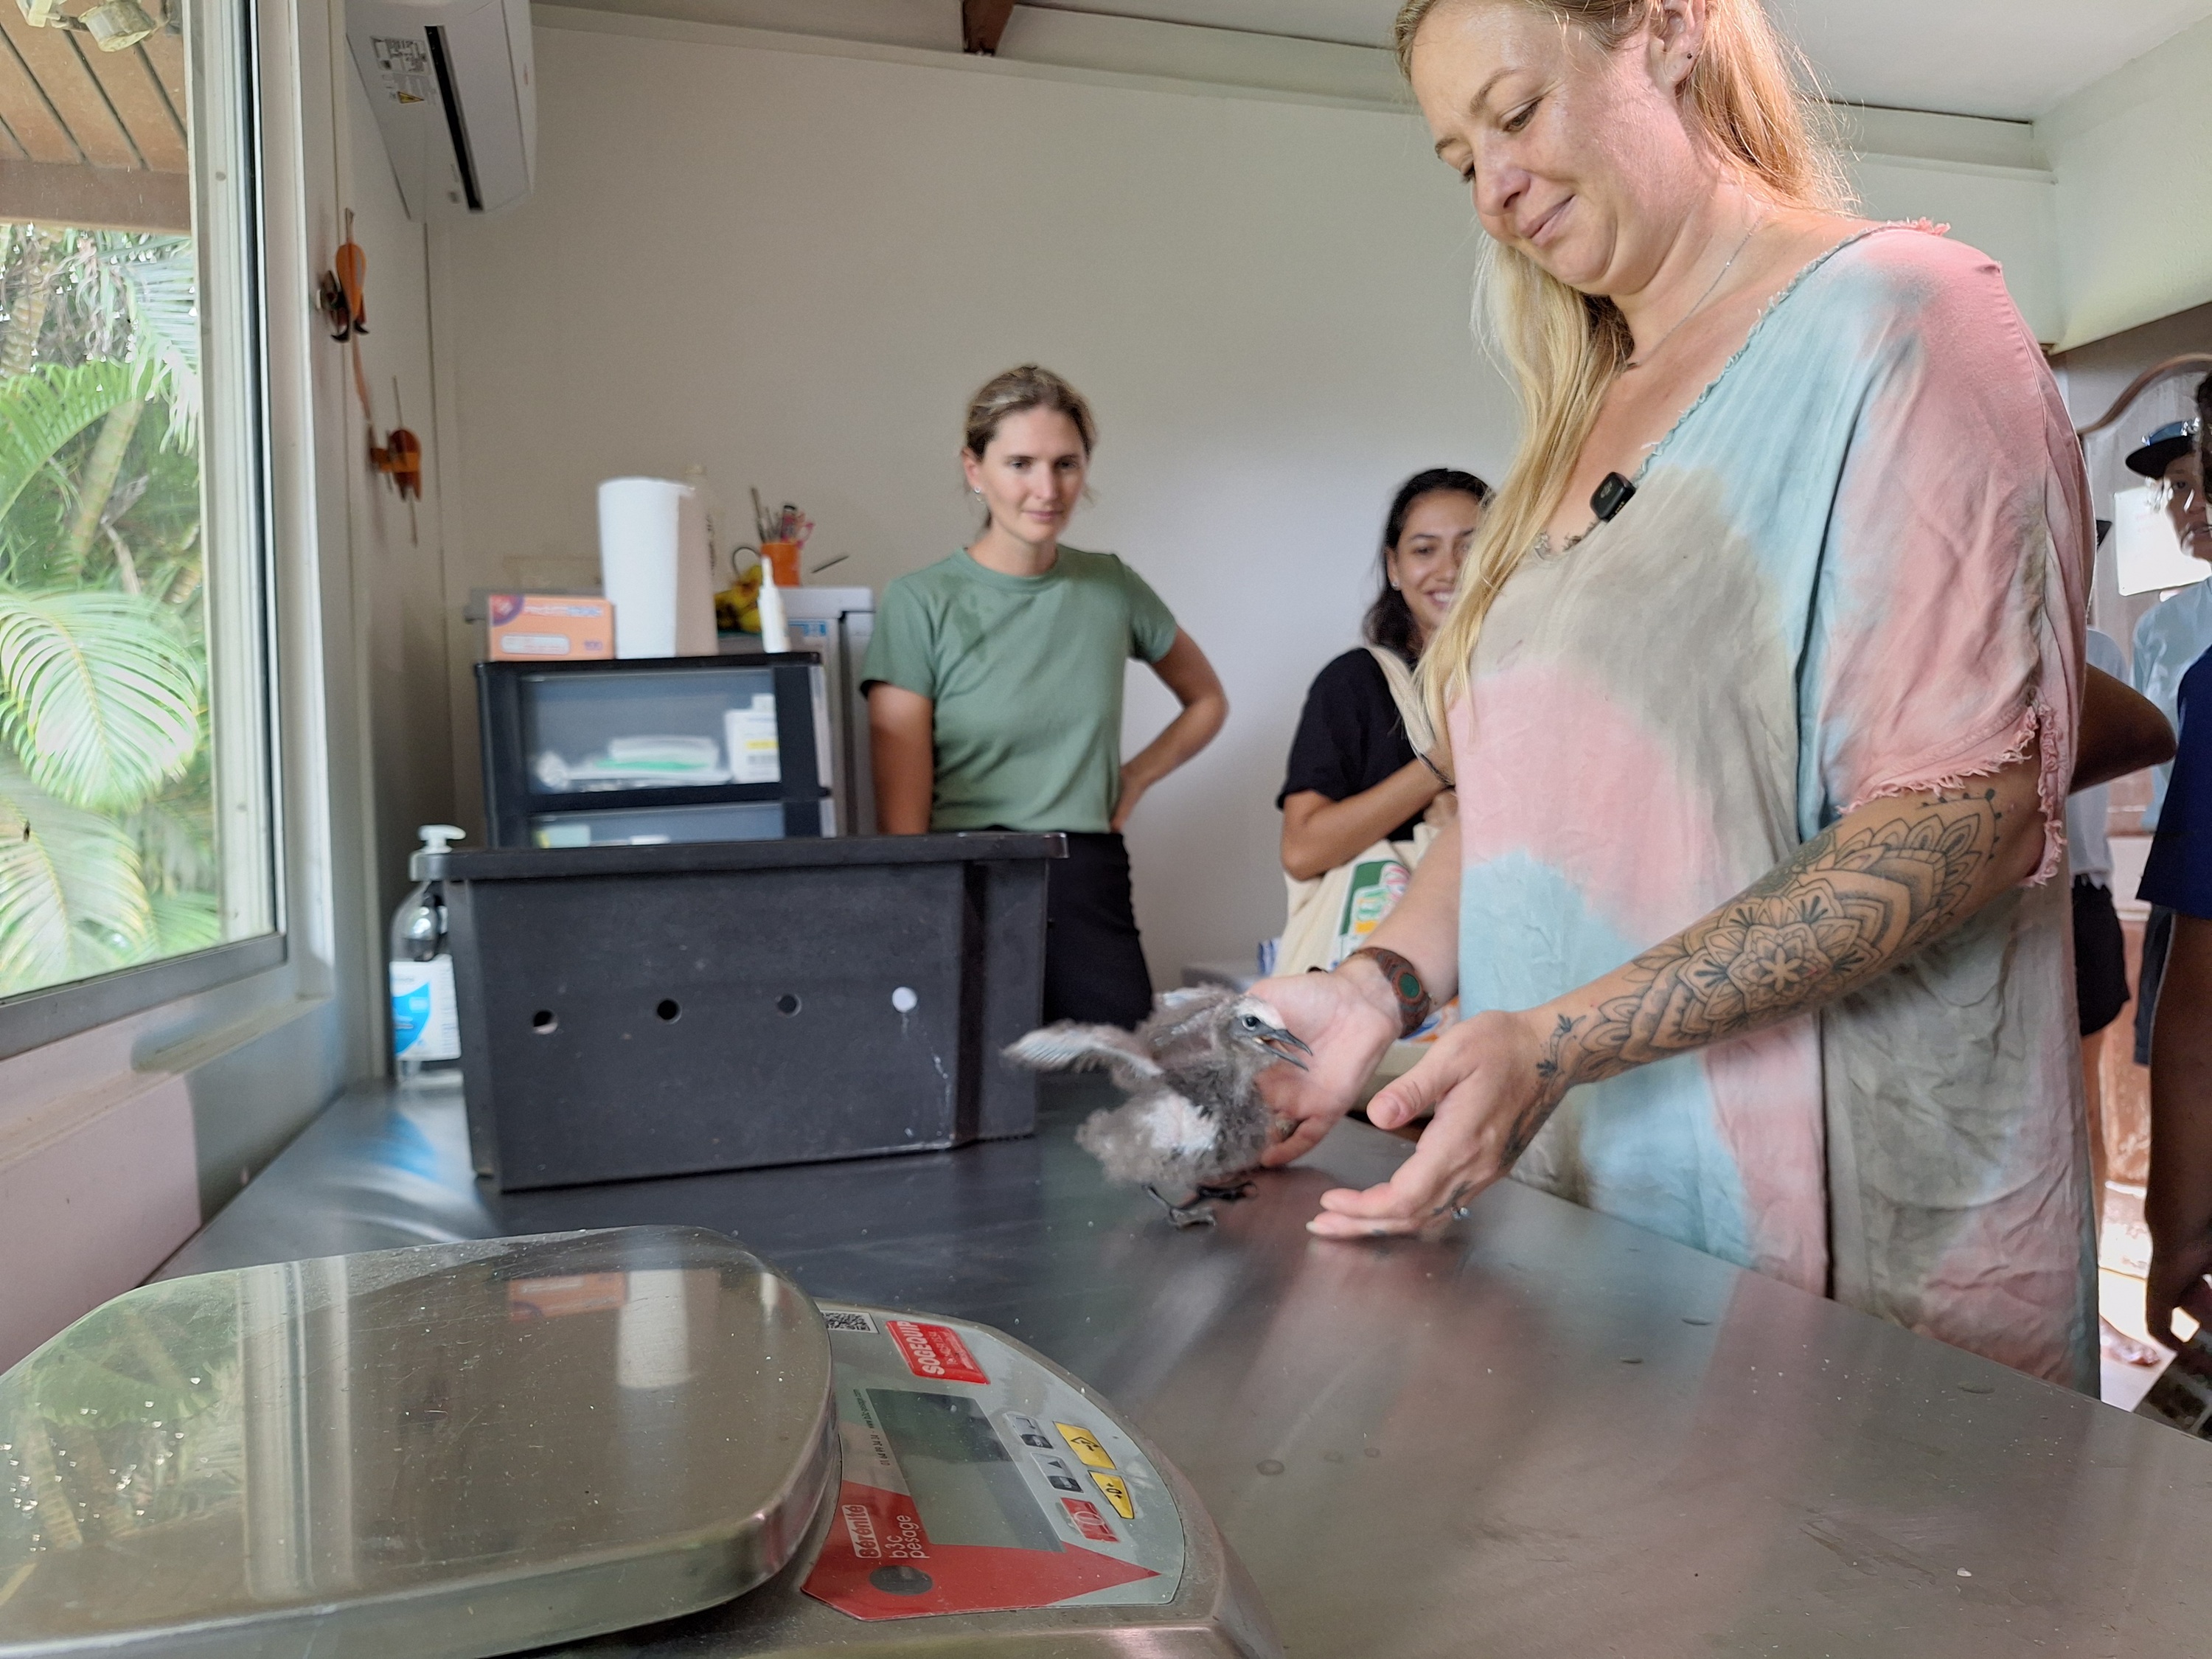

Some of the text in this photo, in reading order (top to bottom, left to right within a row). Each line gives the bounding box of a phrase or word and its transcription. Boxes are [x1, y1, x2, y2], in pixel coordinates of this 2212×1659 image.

[897, 1321, 945, 1375] SOGEQUIP
[844, 1505, 879, 1557] Sérénité
[884, 1535, 909, 1558] b3c
[896, 1514, 931, 1559] pesage
